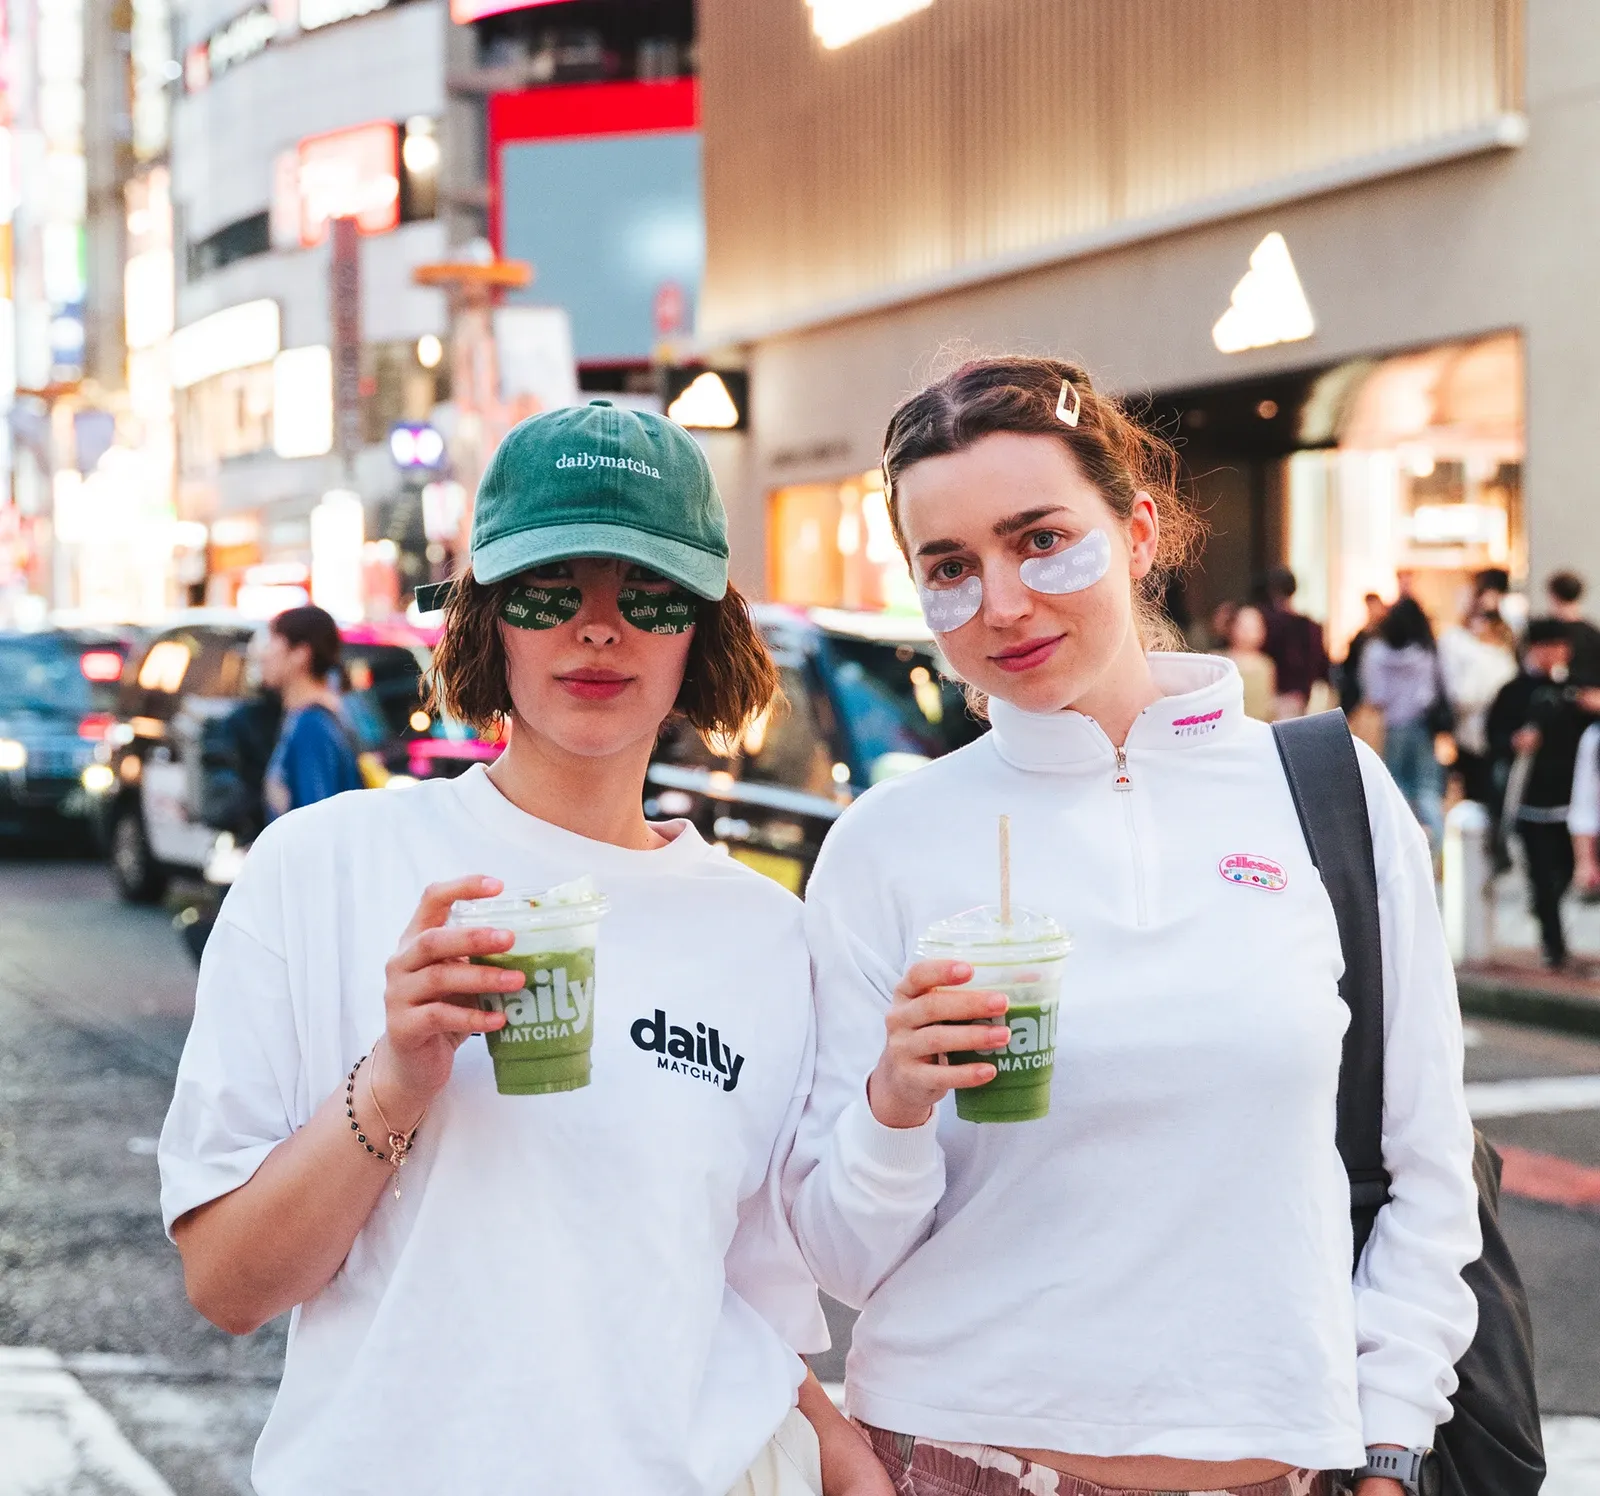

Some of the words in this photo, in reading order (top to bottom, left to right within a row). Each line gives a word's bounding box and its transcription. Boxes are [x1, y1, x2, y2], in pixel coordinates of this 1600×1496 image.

[556, 453, 661, 479] dailymatcha
[525, 588, 552, 604] daily
[505, 603, 529, 618] daily
[631, 606, 658, 618] daily
[666, 603, 689, 615] daily
[652, 623, 678, 635] daily
[1226, 857, 1282, 876] ellesse
[500, 1024, 569, 1042] MATCHA
[630, 1009, 745, 1092] daily
[657, 1057, 719, 1087] MATCHA
